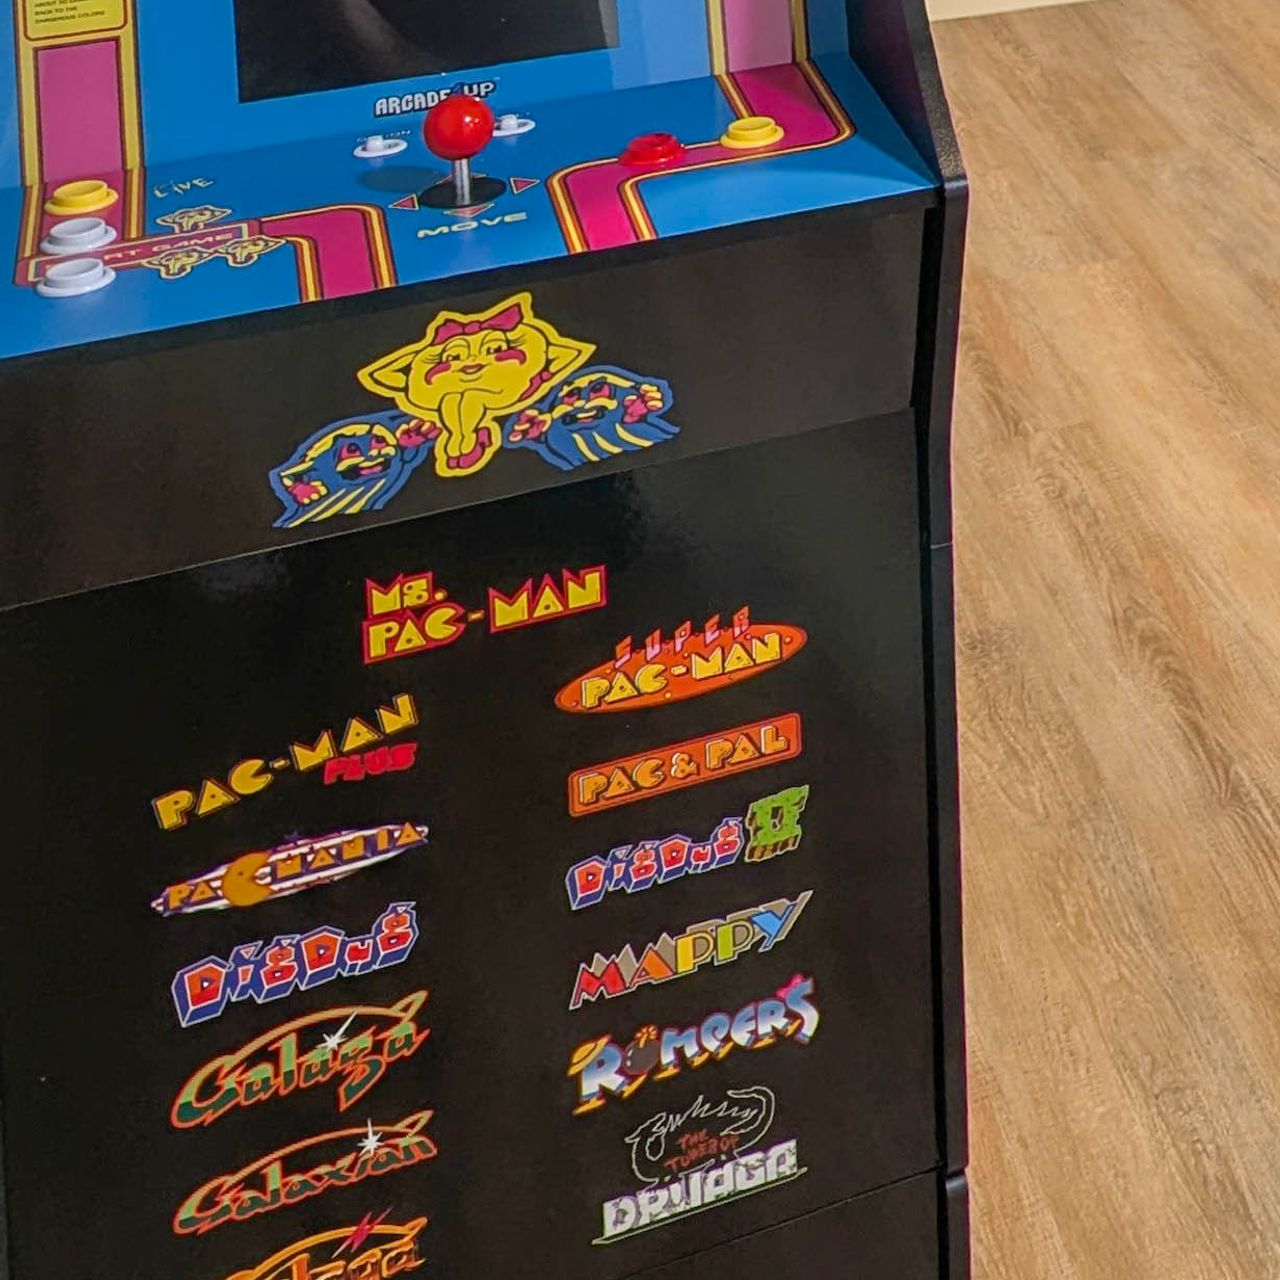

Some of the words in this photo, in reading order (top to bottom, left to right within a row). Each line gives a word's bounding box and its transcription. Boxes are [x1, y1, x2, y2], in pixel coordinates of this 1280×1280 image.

[417, 212, 527, 238] MOVE
[364, 568, 606, 662] PAC-MAN
[614, 606, 750, 669] SUPER
[581, 632, 783, 709] PAC-MAN
[152, 693, 418, 830] PAC-MAN
[323, 741, 418, 787] PLUS
[579, 759, 666, 805] PAC
[671, 752, 700, 779] &
[706, 725, 788, 770] PAL
[570, 891, 813, 1009] MAPPY
[171, 990, 430, 1128] Galaga
